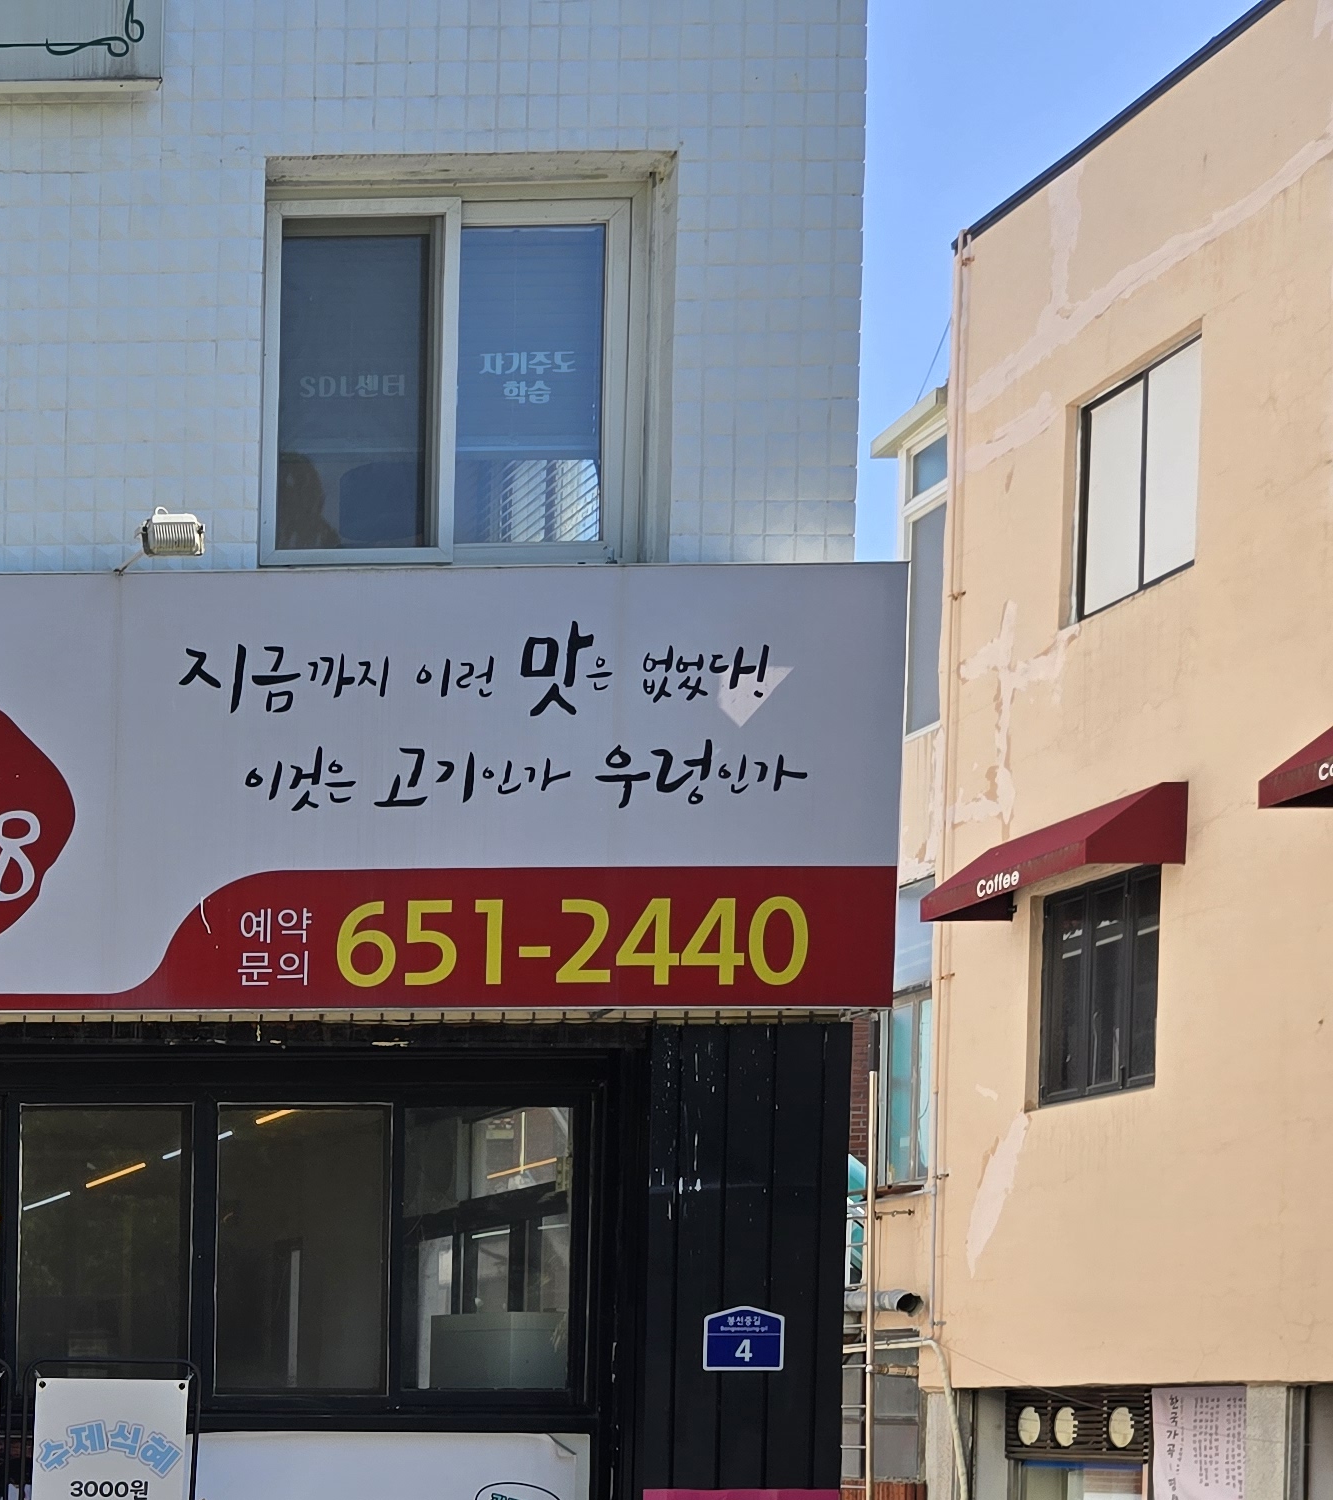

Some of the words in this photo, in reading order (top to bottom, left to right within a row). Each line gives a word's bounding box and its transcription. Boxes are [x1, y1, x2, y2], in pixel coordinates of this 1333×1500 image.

[479, 350, 576, 375] 자기주도
[299, 373, 406, 398] SDL센터
[503, 380, 551, 404] 학습
[178, 644, 389, 714] 지금까지
[414, 655, 494, 702] 이런
[520, 621, 610, 716] 맛은
[640, 643, 768, 702] 없었다!
[244, 746, 356, 811] 이것은
[374, 747, 572, 808] 고기인가
[593, 738, 808, 808] 우렁인가
[976, 869, 1020, 898] Coffee
[239, 906, 312, 945] 예약
[336, 895, 808, 987] 651-2440
[236, 950, 311, 987] 문의
[735, 1339, 753, 1362] 4
[38, 1421, 182, 1477] 수제식혜
[70, 1480, 148, 1500] 3000원
